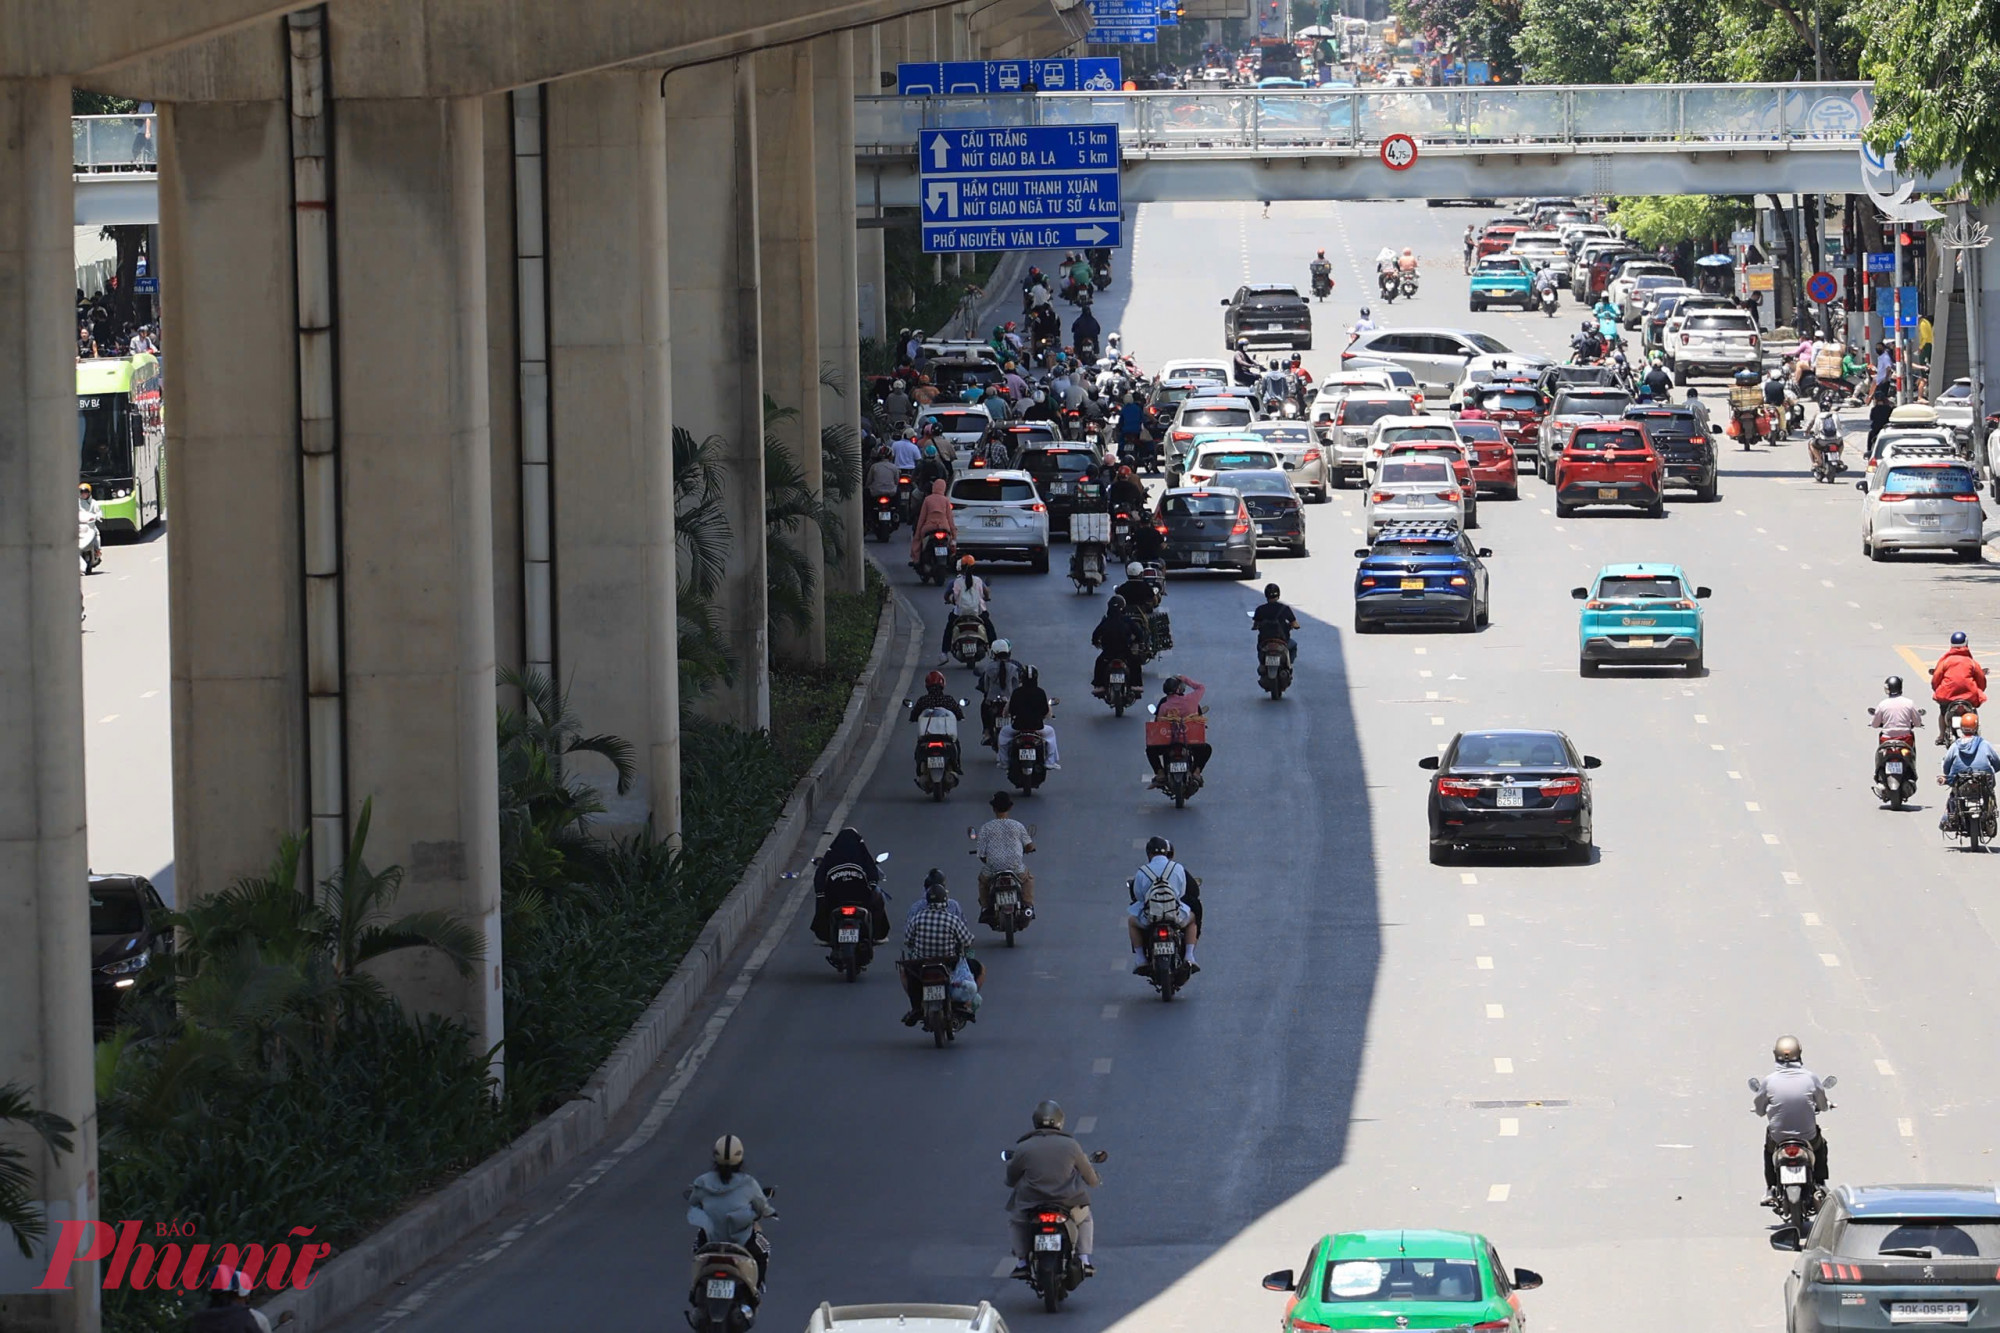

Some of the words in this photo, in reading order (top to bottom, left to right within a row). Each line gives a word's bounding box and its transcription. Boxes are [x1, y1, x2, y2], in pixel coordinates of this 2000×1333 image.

[961, 130, 984, 148] CẦU
[989, 128, 1028, 148] TRẮNG
[1068, 132, 1086, 146] 1,5
[1090, 131, 1108, 145] km
[962, 150, 984, 167] NÚT
[990, 152, 1016, 166] GIAO
[1020, 152, 1036, 166] BA
[1040, 150, 1056, 165] LA
[1078, 150, 1086, 164] 5
[1090, 150, 1108, 164] km
[963, 178, 988, 197] HẦM
[992, 182, 1018, 196] CHUI
[1024, 180, 1062, 196] THANH
[1068, 178, 1098, 194] XUÂN
[964, 199, 986, 216] NÚT
[990, 200, 1016, 215] GIAO
[1020, 198, 1042, 214] NGÃ
[1048, 199, 1062, 213] TƯ
[1067, 194, 1082, 212] SỞ
[1089, 198, 1096, 212] 4
[1099, 198, 1116, 212] km
[933, 228, 957, 248] PHỐ
[960, 228, 1006, 247] NGUYỄN
[1011, 228, 1034, 246] VĂN
[1038, 228, 1060, 248] LỘC
